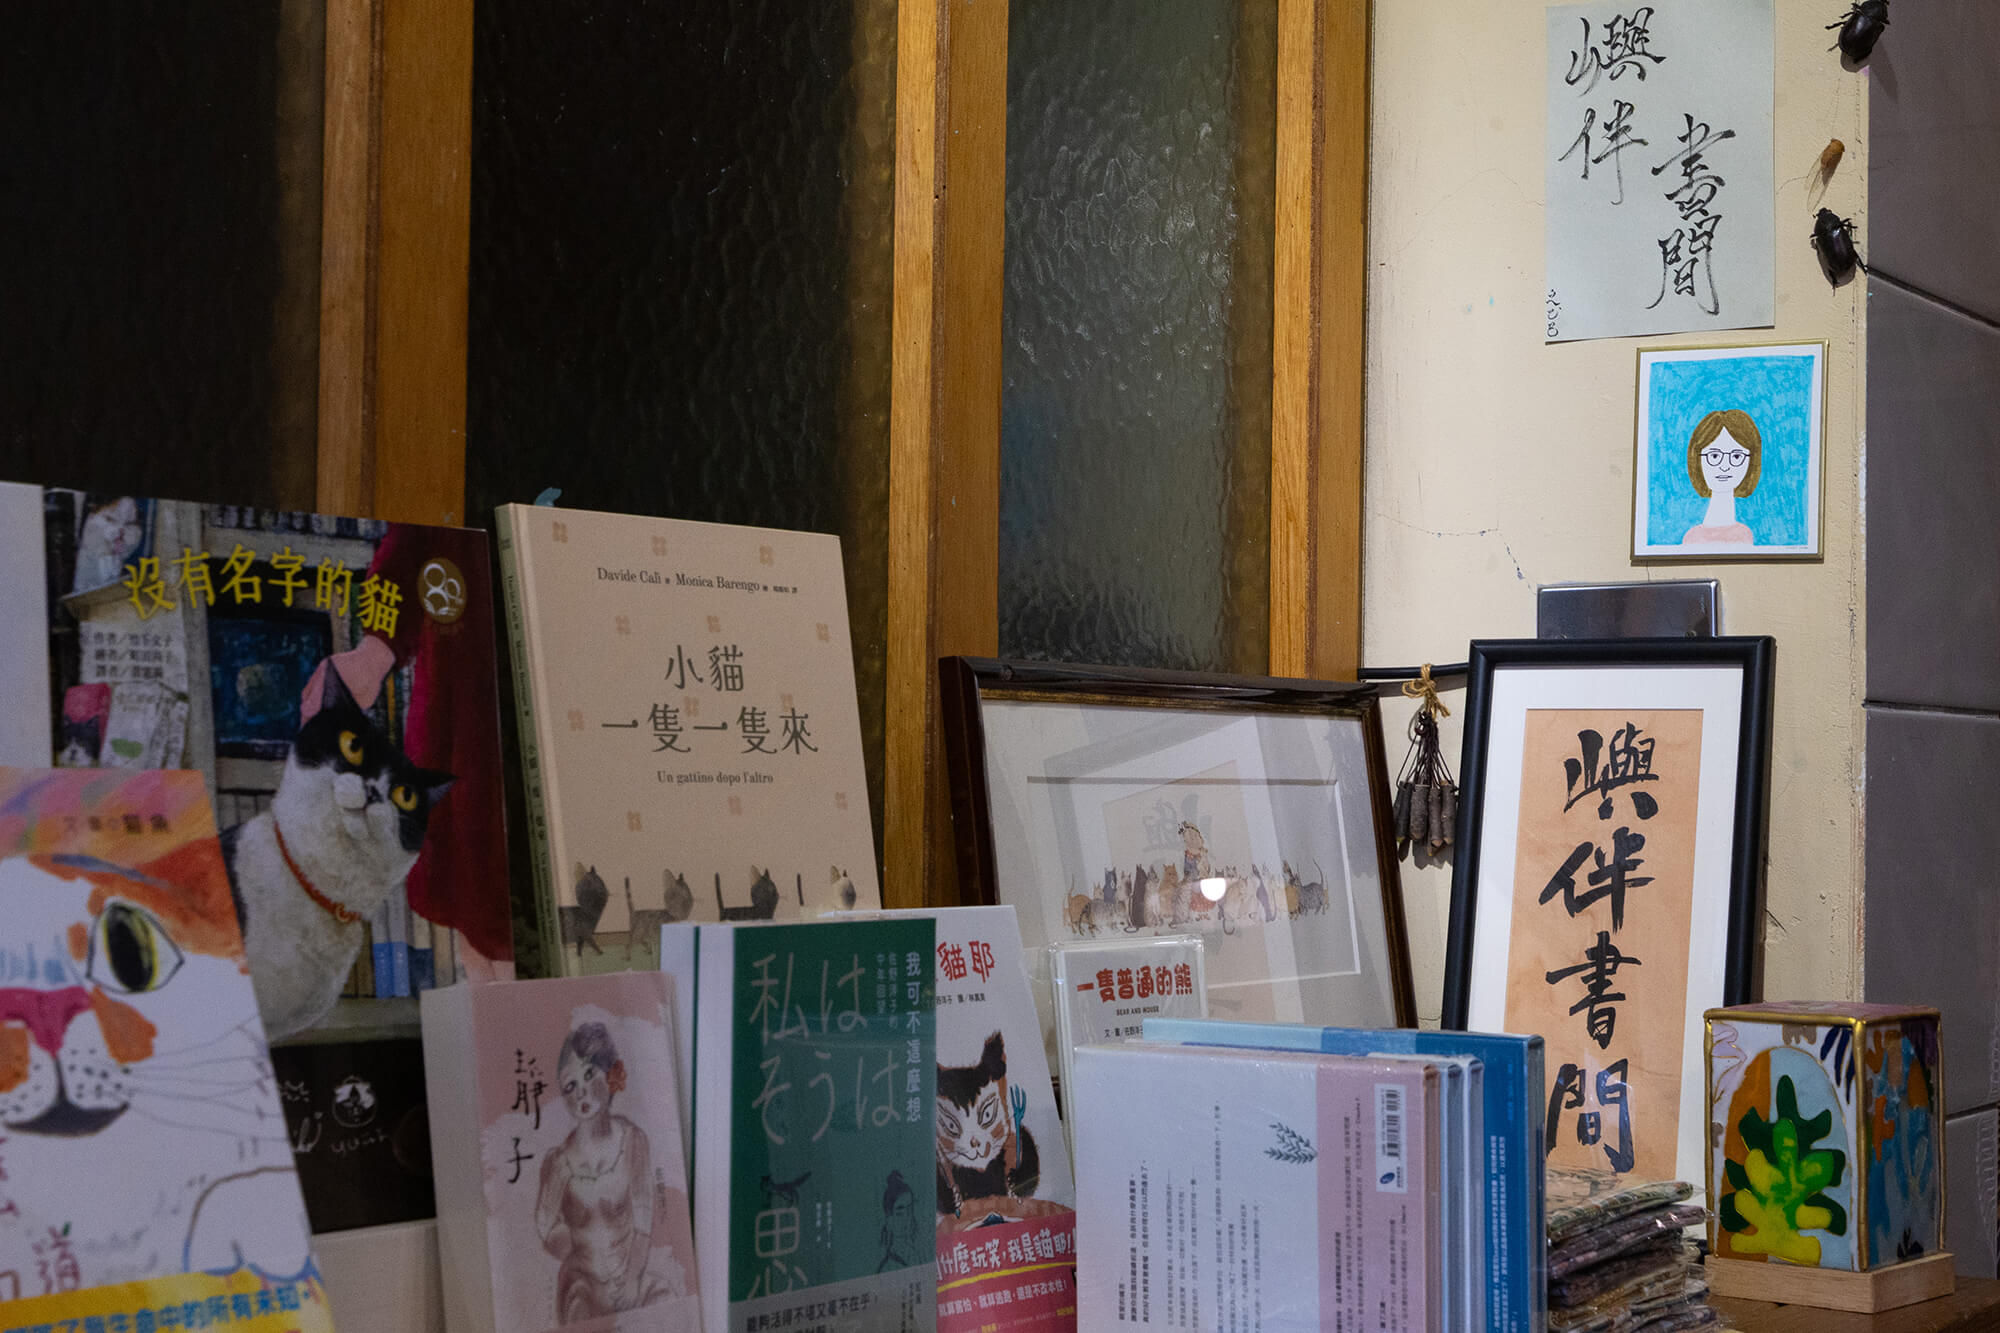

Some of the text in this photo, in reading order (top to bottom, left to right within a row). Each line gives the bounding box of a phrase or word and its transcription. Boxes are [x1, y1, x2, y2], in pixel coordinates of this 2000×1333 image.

[596, 567, 637, 584] Davide
[675, 572, 714, 589] Monica
[716, 576, 760, 594] Barengo
[663, 644, 745, 692] 小貓
[601, 703, 819, 755] 一隻一隻來
[657, 770, 674, 784] Un
[676, 771, 714, 786] gattino
[715, 771, 741, 786] dopo
[1538, 721, 1660, 1173] 嶼伴書間
[749, 950, 868, 1046] 私は
[1076, 962, 1194, 1004] 一隻普通的熊
[1116, 1006, 1160, 1017] BEAR AND MOUSE
[905, 951, 923, 1124] 我可不這麼想
[751, 1049, 901, 1145] そうは
